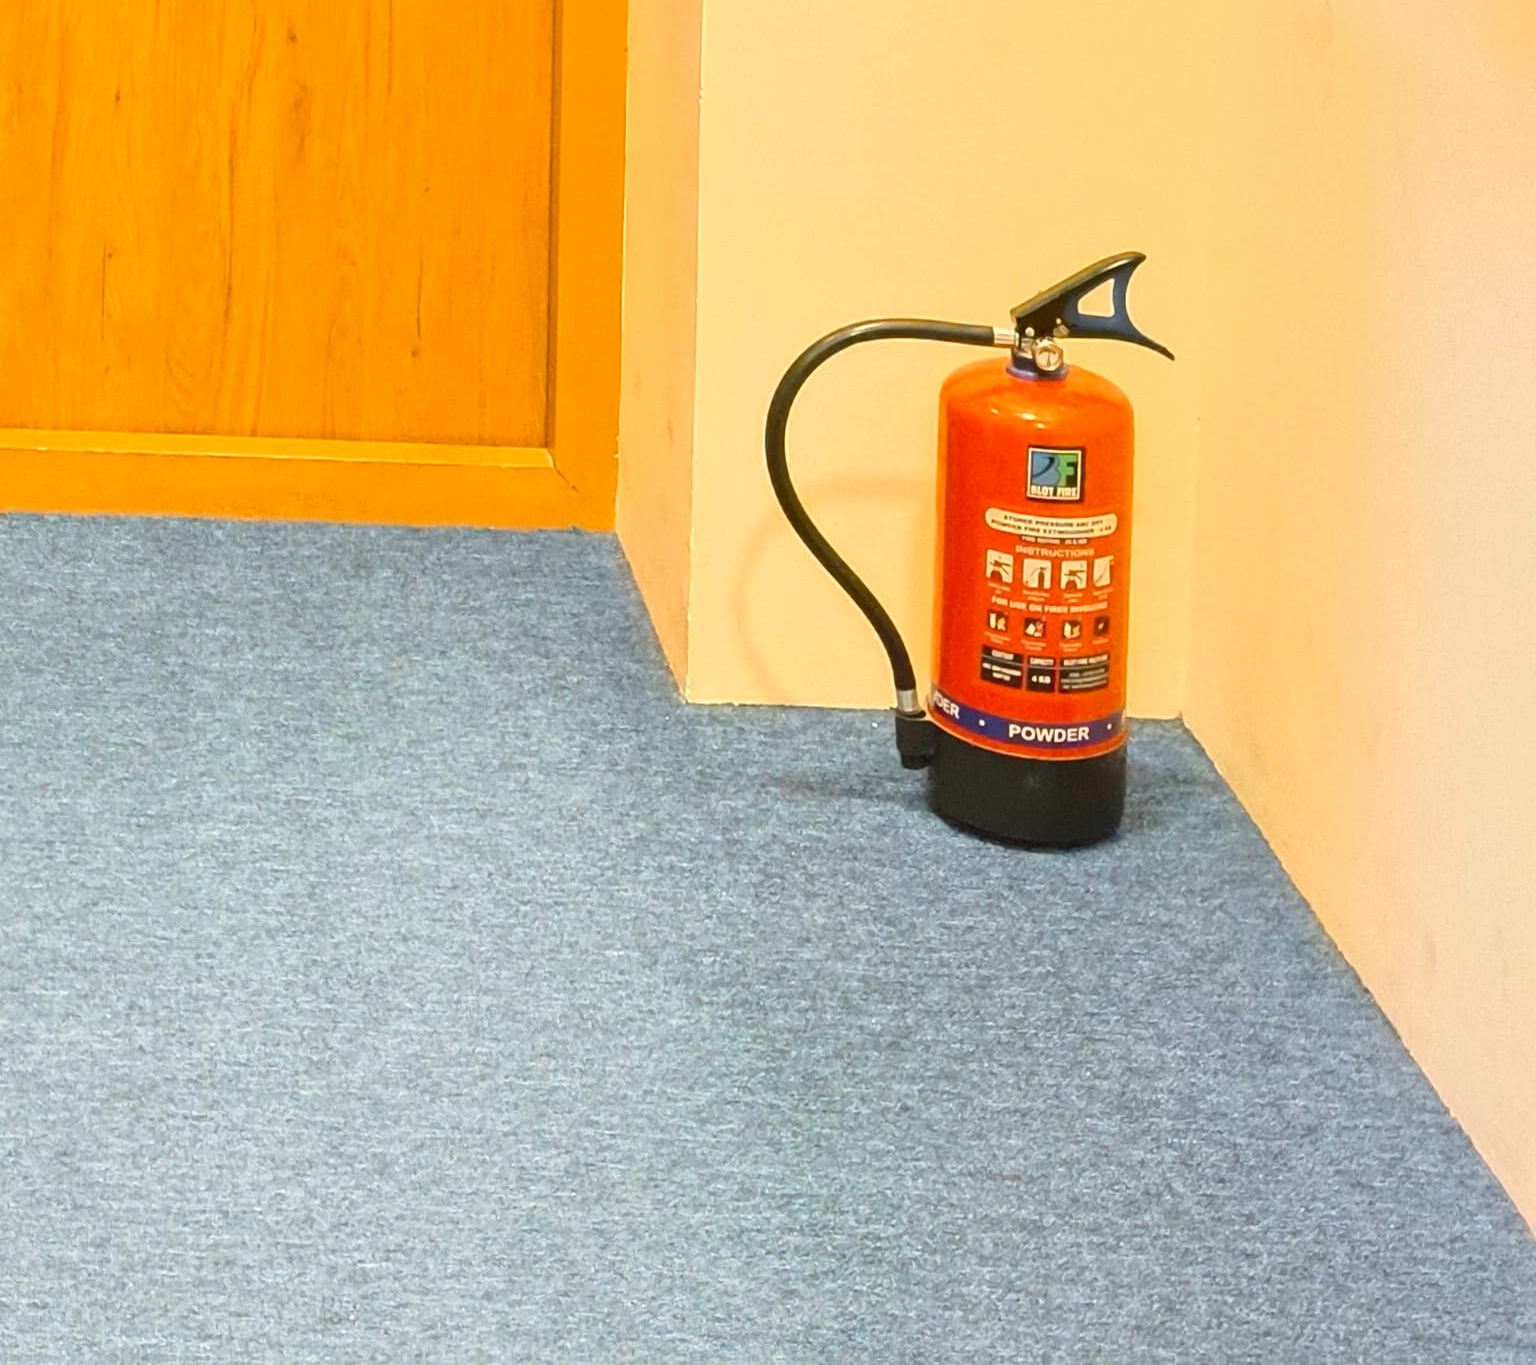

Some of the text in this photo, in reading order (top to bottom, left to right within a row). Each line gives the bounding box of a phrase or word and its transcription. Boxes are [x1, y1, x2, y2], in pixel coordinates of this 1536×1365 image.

[1056, 487, 1077, 497] FIRE
[1015, 545, 1095, 557] INSTRUCTIONS
[991, 595, 1008, 606] FOR
[1008, 723, 1090, 743] POWDER
